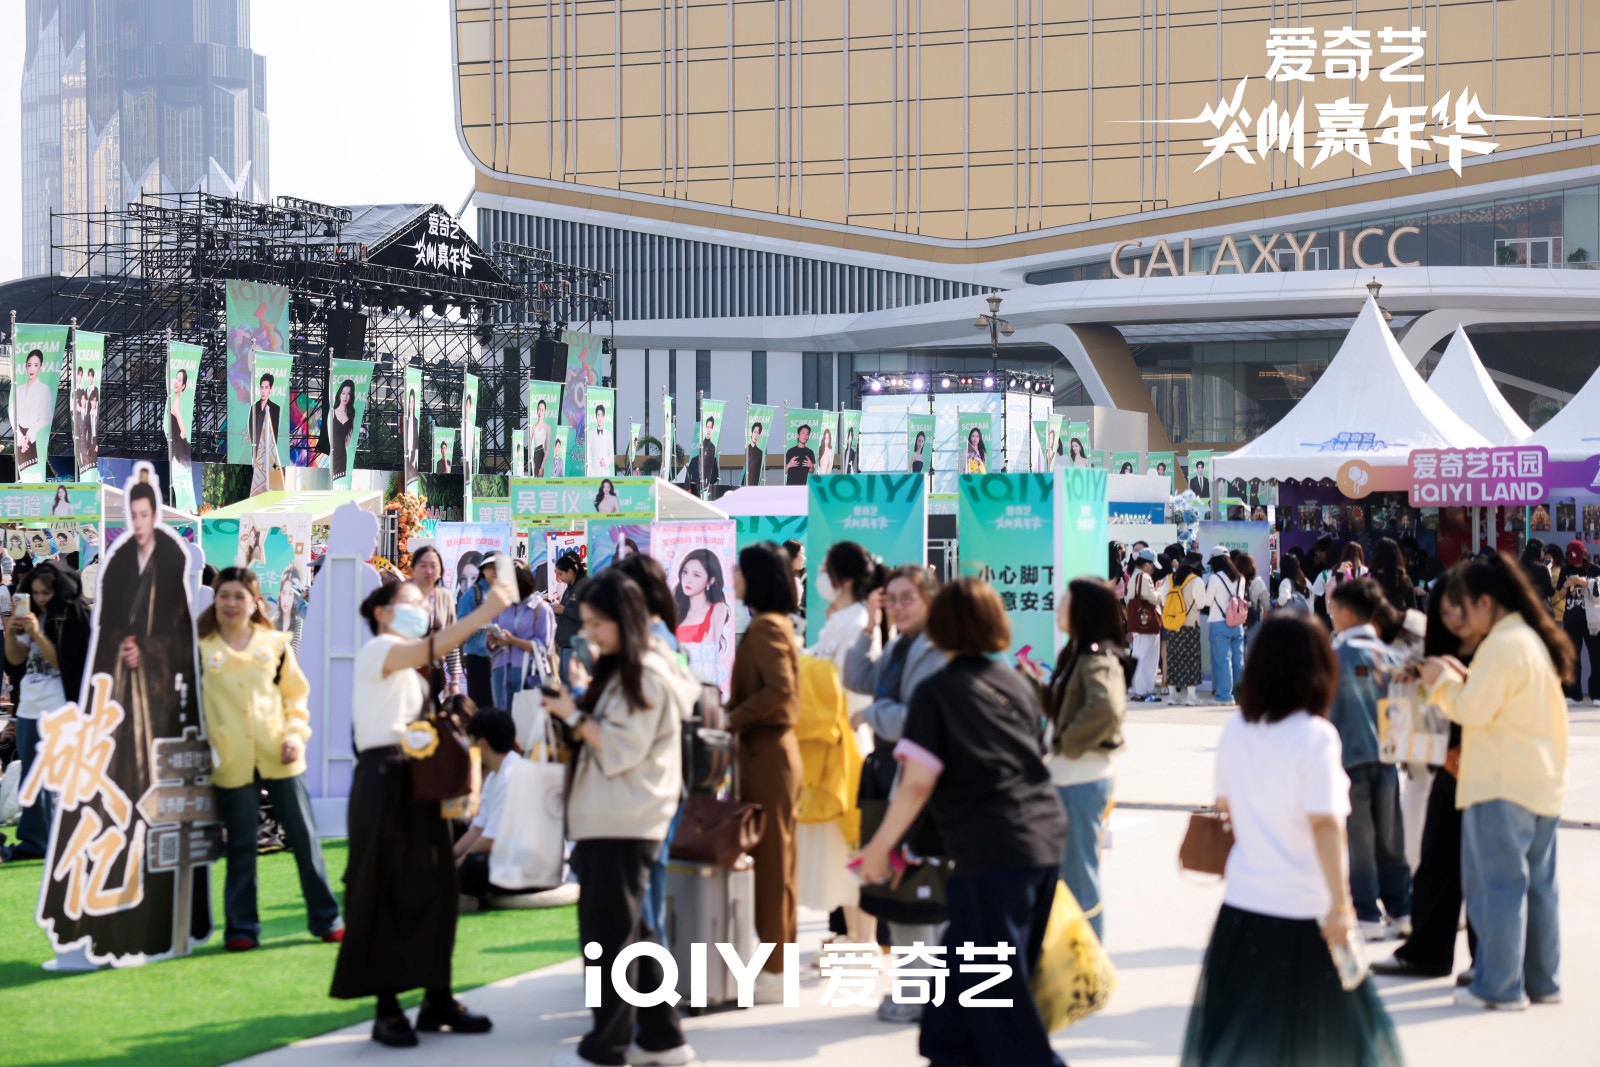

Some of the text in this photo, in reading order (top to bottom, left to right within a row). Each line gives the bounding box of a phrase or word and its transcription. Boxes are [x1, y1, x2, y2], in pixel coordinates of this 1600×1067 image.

[428, 212, 461, 240] 爱奇艺
[412, 232, 475, 277] 尖叫嘉年华
[1110, 227, 1421, 279] GALAXY ICC
[1413, 450, 1543, 479] 爱奇艺乐园
[812, 474, 924, 503] iQIYI
[962, 473, 1054, 503] iQIY
[1064, 468, 1108, 502] iQIYI
[1413, 481, 1544, 503] iQIYI LAND
[0, 495, 40, 517] 若晗
[516, 490, 580, 514] 吴宣仪
[979, 565, 1054, 586] 小心脚下
[999, 591, 1054, 612] 意安全
[20, 674, 143, 918] 破亿
